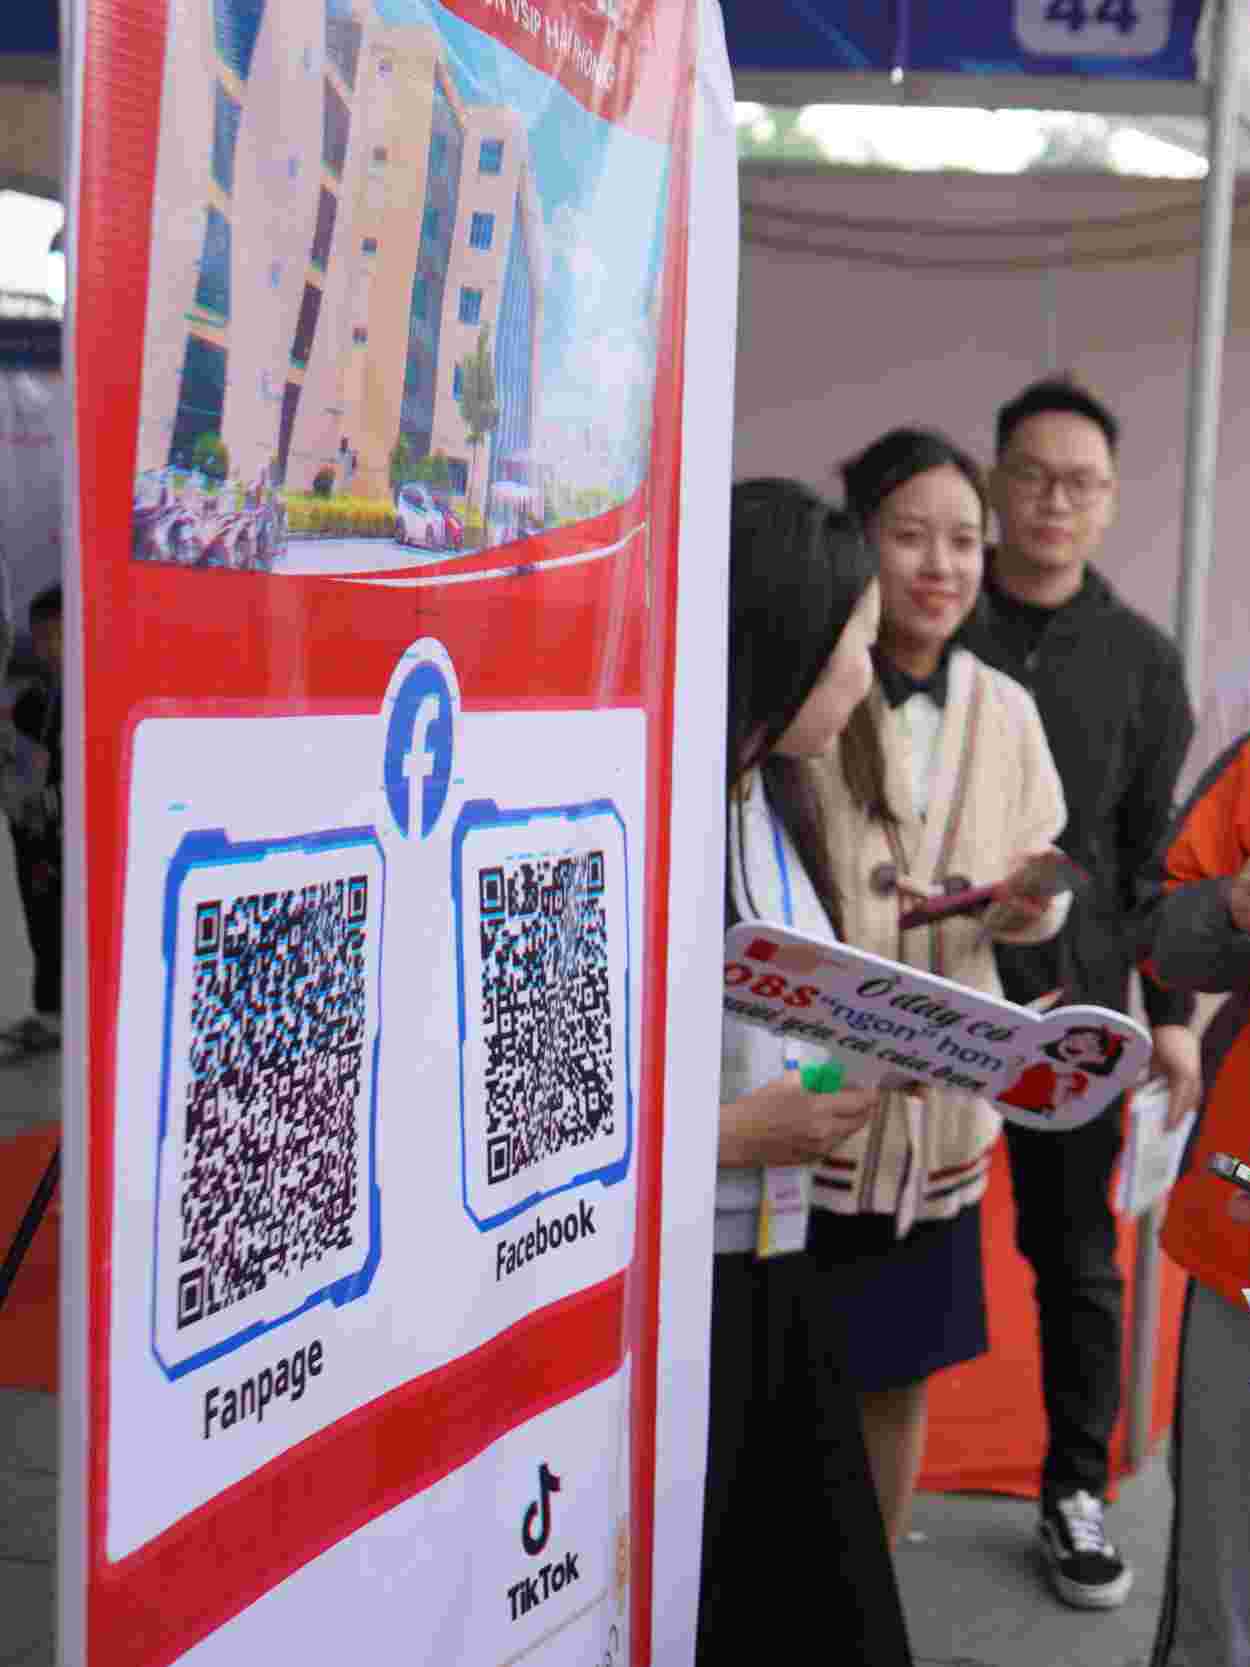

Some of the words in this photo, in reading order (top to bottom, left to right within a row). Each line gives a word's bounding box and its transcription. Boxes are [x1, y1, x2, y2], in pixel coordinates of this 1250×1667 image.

[496, 1200, 596, 1281] Facebook
[203, 1339, 323, 1439] Fanpage
[507, 1552, 579, 1620] TikTok
